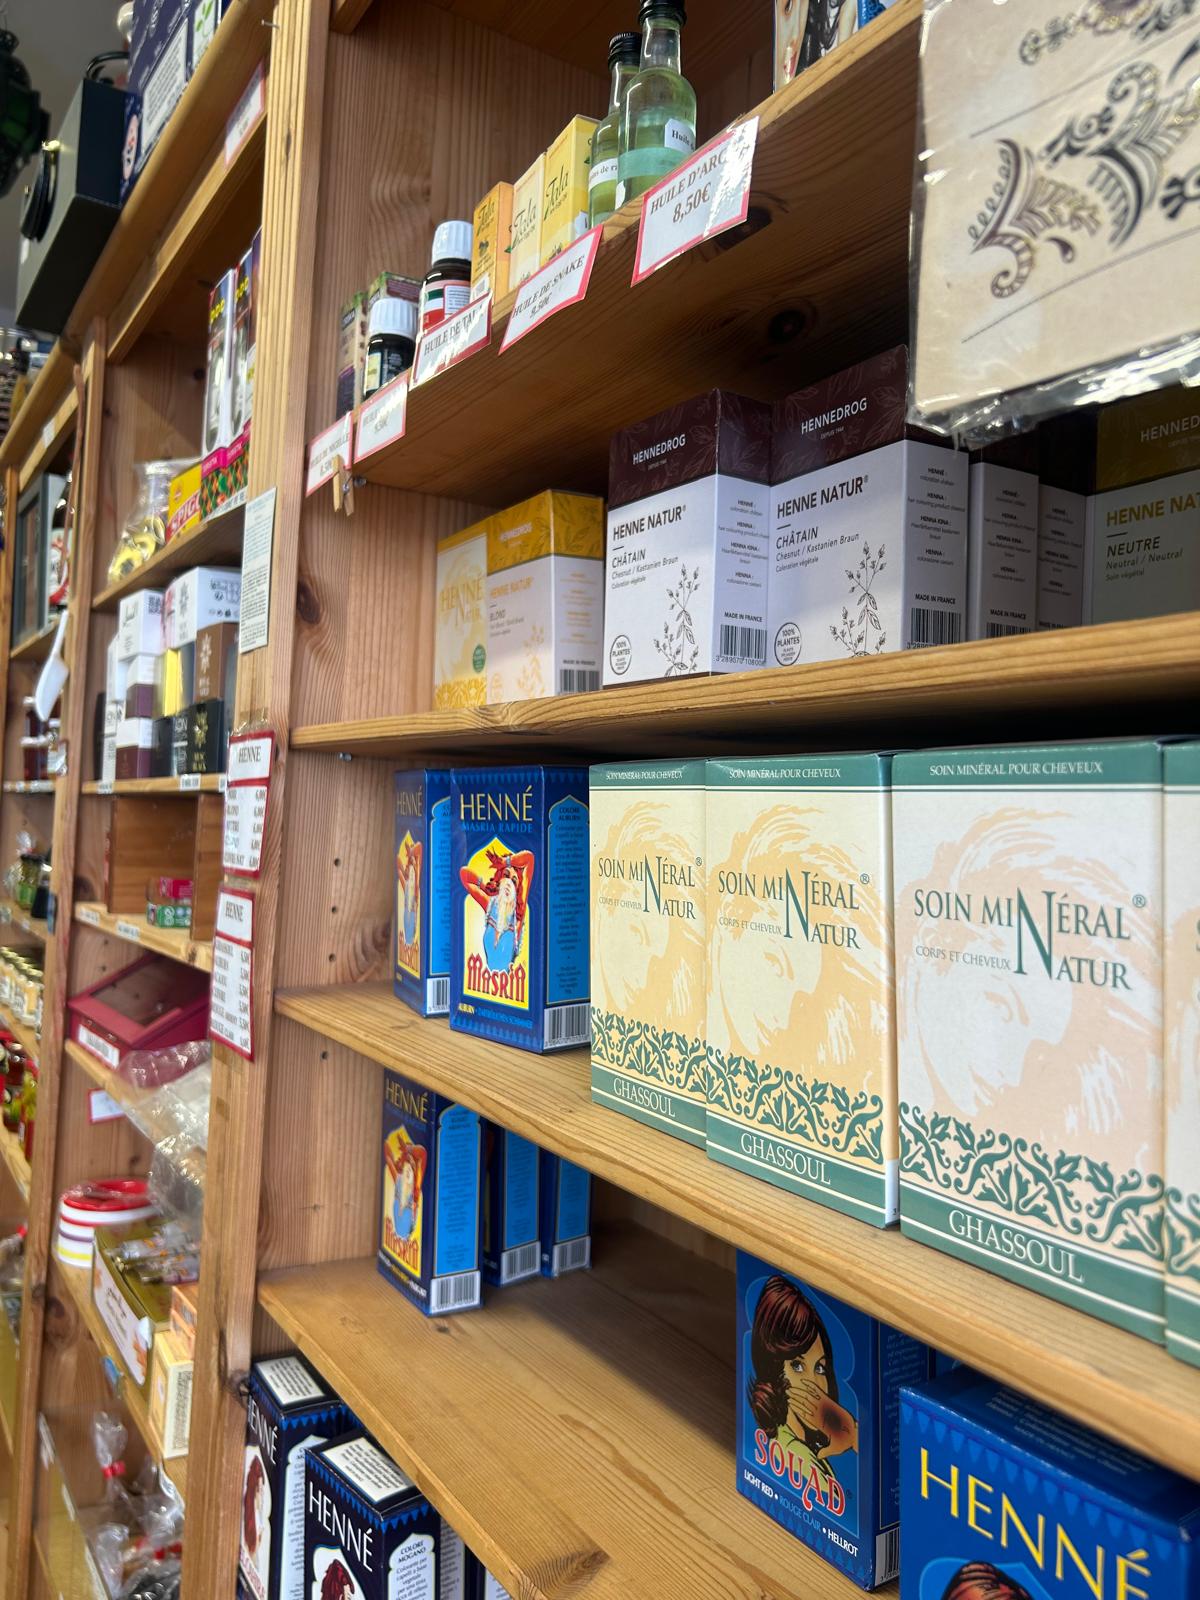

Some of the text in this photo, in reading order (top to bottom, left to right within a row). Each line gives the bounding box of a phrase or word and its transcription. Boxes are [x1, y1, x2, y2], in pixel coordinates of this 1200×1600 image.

[650, 178, 687, 215] HUILE
[672, 182, 712, 223] 8,50€
[513, 290, 540, 318] HUILE
[539, 281, 551, 296] DE
[424, 328, 448, 356] HUILE
[801, 397, 868, 435] HENNEDROG
[632, 433, 686, 465] HENNEDROG
[777, 491, 817, 519] HENNE
[1106, 499, 1165, 527] HENNE
[613, 515, 645, 541] HENNE
[776, 526, 819, 550] CHÂTAIN
[612, 548, 646, 568] CHÂTAIN
[775, 548, 800, 562] Chesnut
[806, 540, 838, 553] Kastanien
[840, 533, 860, 546] Braun
[1106, 535, 1161, 557] NEUTRE
[1106, 549, 1183, 569] Neutral Neutral
[636, 561, 661, 573] Kastanien
[662, 556, 679, 567] Braun
[915, 594, 930, 602] MADE
[937, 596, 956, 605] FRANCE
[724, 611, 738, 619] MADE
[744, 615, 763, 623] FRANCE
[777, 636, 800, 647] PLANTES
[238, 745, 261, 764] HENNE
[640, 771, 656, 779] POUR
[656, 770, 683, 779] CHEVEUX
[729, 767, 841, 779] SOIN MINÉRAL POUR CHEVEUX
[929, 761, 1103, 776] SOIN MINÉRAL POUR CHEVEUX
[396, 785, 422, 817] HENNÉ
[459, 785, 533, 822] HENNÉ
[461, 822, 533, 833] MASRIA RAPIDE
[598, 857, 625, 880] SOIN
[718, 870, 756, 897] SOIN
[225, 900, 244, 922] HENNE
[620, 899, 642, 910] CHEVEUX
[914, 888, 971, 922] SOIN
[719, 916, 782, 935] CORPS ET CHEVEUX
[915, 945, 1011, 971] CORPS ET CHEVEUX
[467, 953, 527, 1003] MASRIA
[386, 1078, 428, 1124] HENNÉ
[613, 1077, 676, 1118] GHASSOUL
[740, 1132, 831, 1185] GHASSOUL
[948, 1209, 1085, 1284] GHASSOUL
[754, 1428, 846, 1517] SOUAD
[309, 1481, 373, 1572] HENNÉ
[744, 1469, 859, 1557] LIGHT RED ROUGE CLAIR HELLROT
[920, 1446, 1152, 1600] HENNÉ
[398, 1547, 426, 1564] MOGANO
[400, 1540, 424, 1555] COLORE
